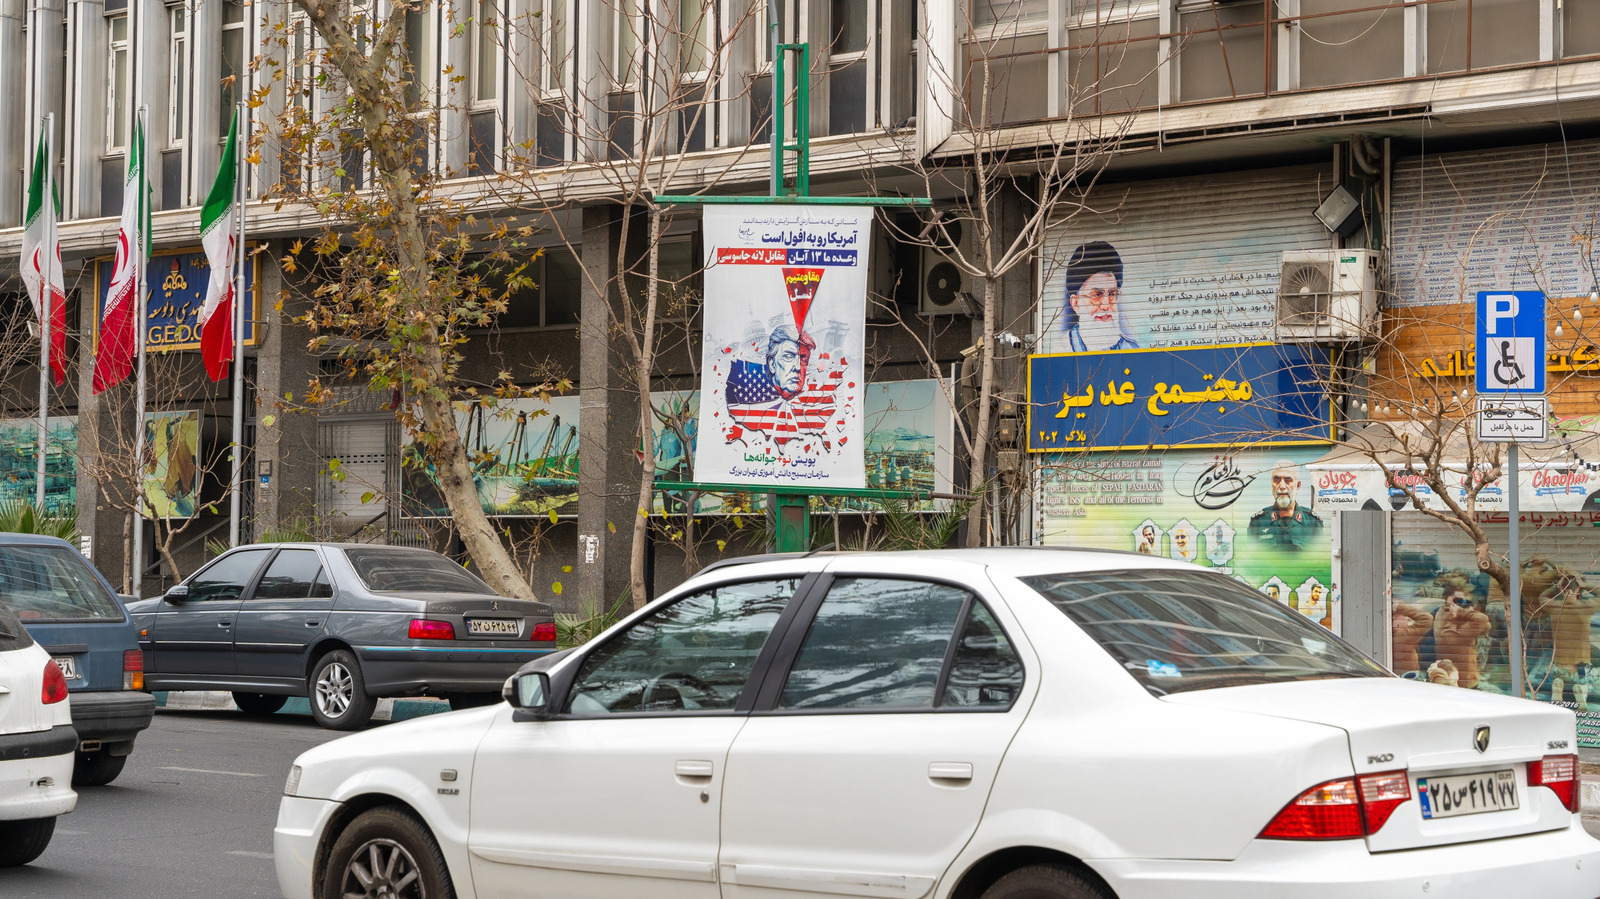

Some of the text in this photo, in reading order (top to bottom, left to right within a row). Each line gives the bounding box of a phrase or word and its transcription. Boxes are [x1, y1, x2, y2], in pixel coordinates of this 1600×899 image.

[761, 231, 784, 243] است
[784, 228, 806, 247] افول
[806, 232, 816, 246] به
[818, 235, 828, 247] رو
[828, 229, 858, 247] آمریکا
[718, 249, 857, 266] وعده ما ۱۳ آبان مقابل لانه جاسوسی
[786, 271, 820, 285] مقاومتیم
[790, 288, 812, 302] نسل
[1486, 294, 1520, 334] P
[1055, 368, 1252, 419] مجتمع غدیر
[1490, 423, 1534, 433] حمل با جرثقیل
[1039, 430, 1087, 446] پلاک ۲۰۲
[790, 456, 816, 467] پویش
[729, 466, 830, 480] سازمان بسیج دانش آموزی تهران بزرگ
[1319, 470, 1357, 490] چوپان
[1532, 469, 1589, 495] Choopan
